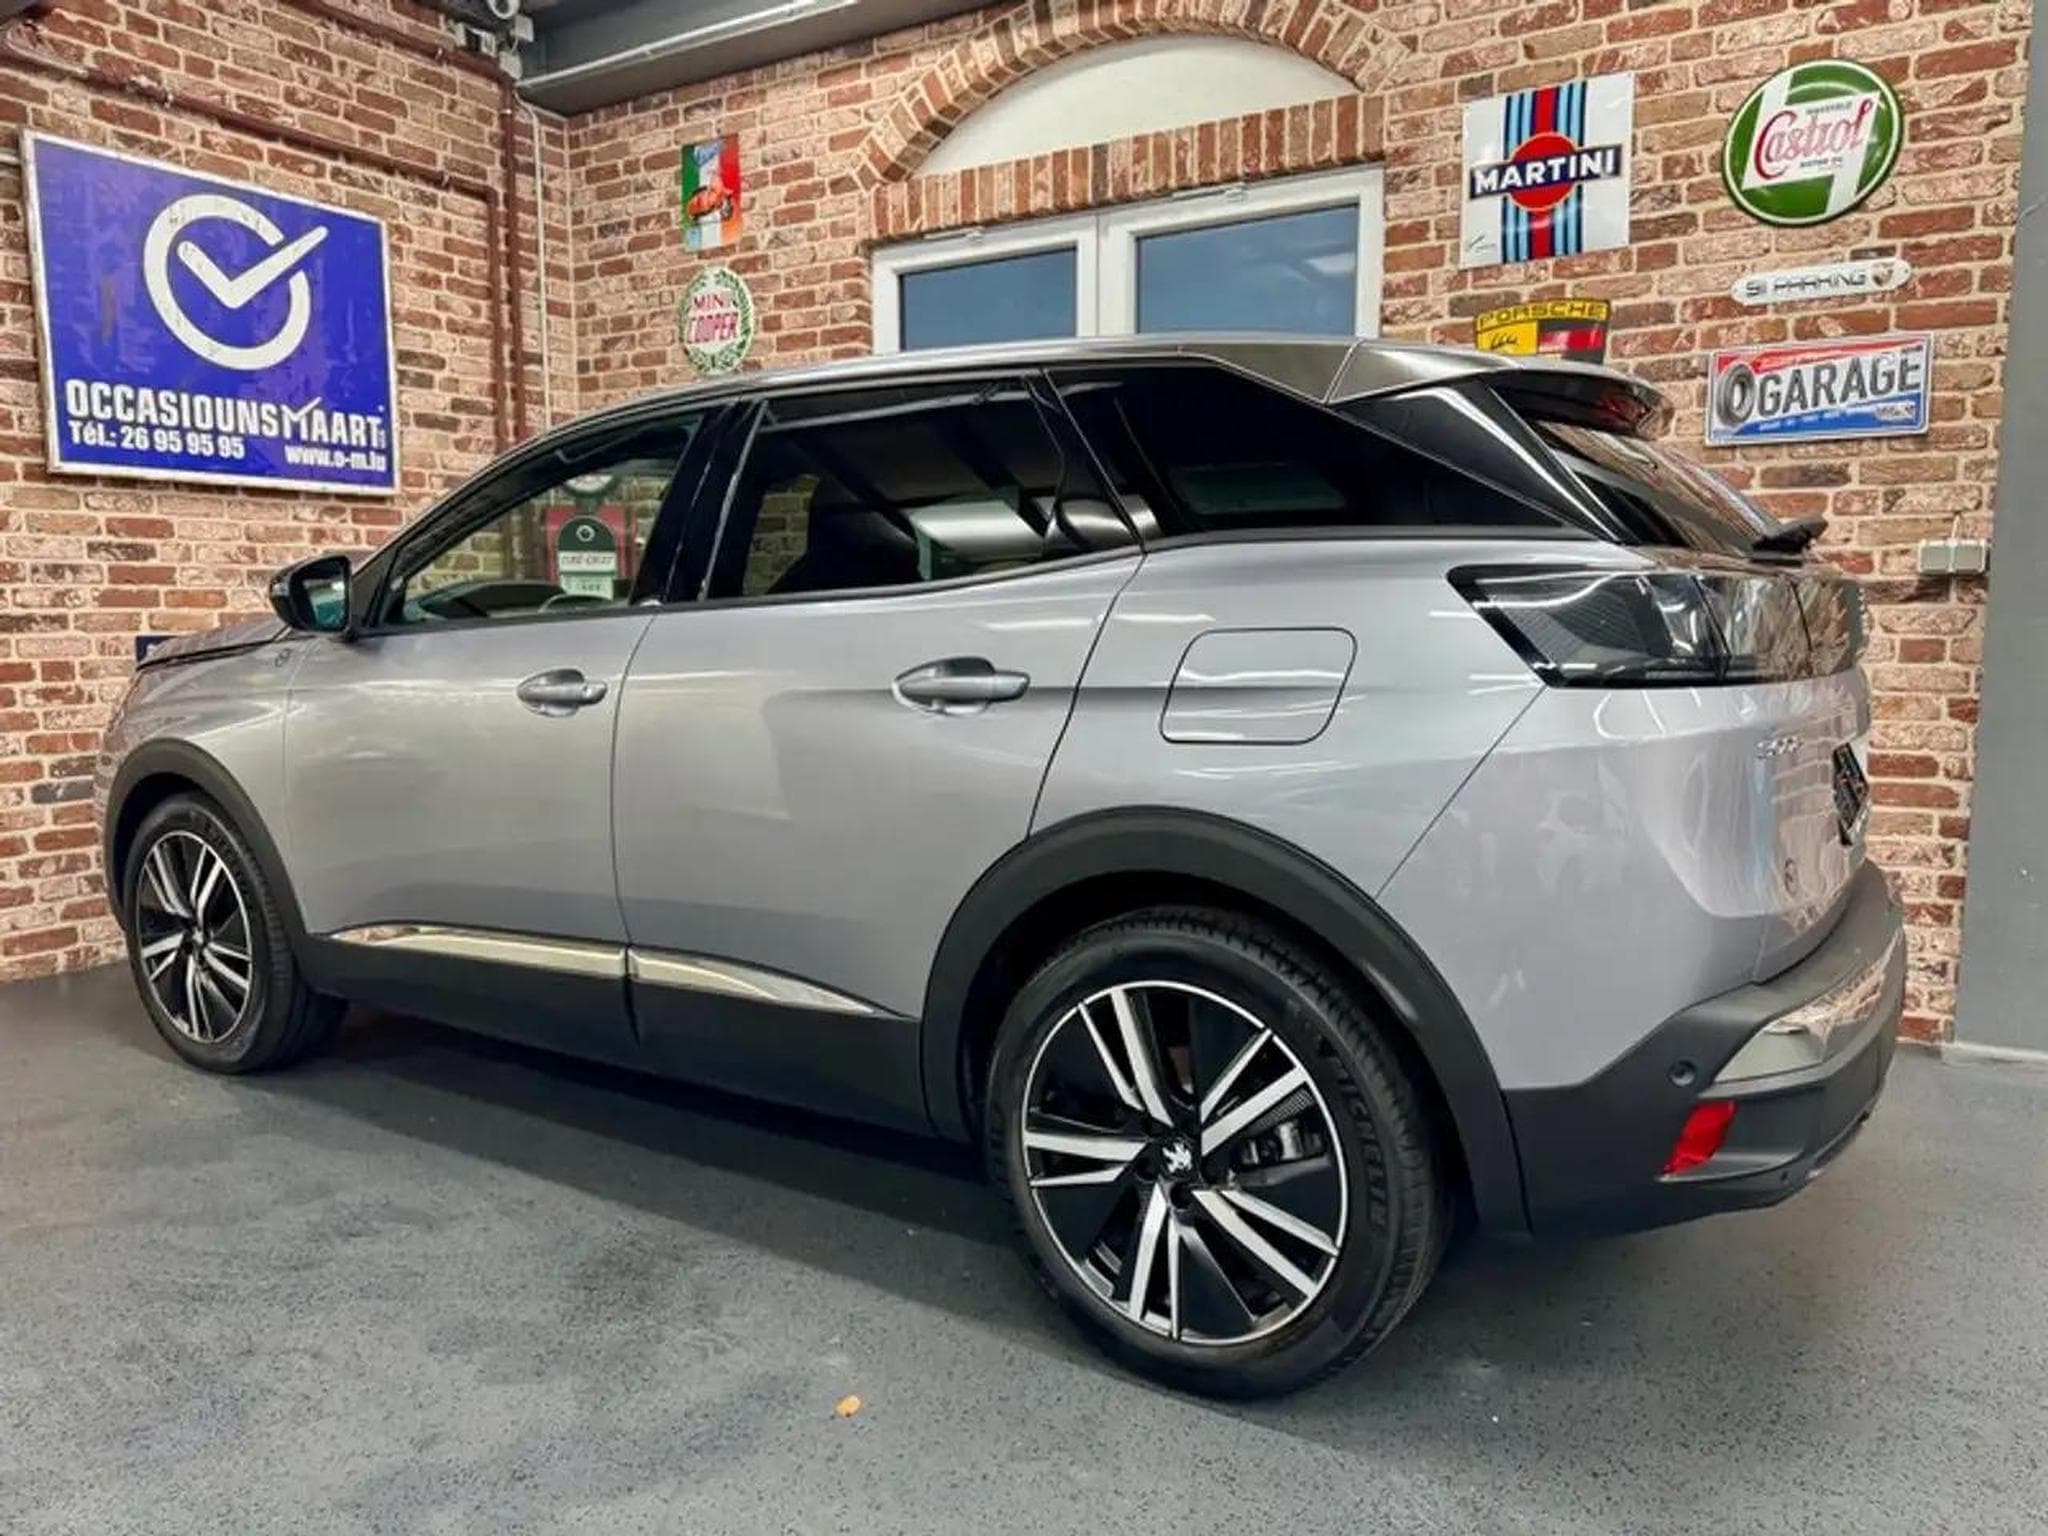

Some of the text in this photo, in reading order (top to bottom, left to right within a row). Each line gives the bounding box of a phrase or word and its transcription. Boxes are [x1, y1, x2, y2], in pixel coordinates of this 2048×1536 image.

[1754, 99, 1874, 180] Castrol
[1473, 149, 1615, 195] MARTINI
[686, 311, 739, 344] COOPER
[1479, 302, 1607, 329] PORSCHE
[1757, 345, 1924, 417] GARAGE
[120, 425, 150, 451] 26
[153, 428, 183, 454] 95
[186, 431, 214, 457] 95
[217, 434, 245, 460] 95
